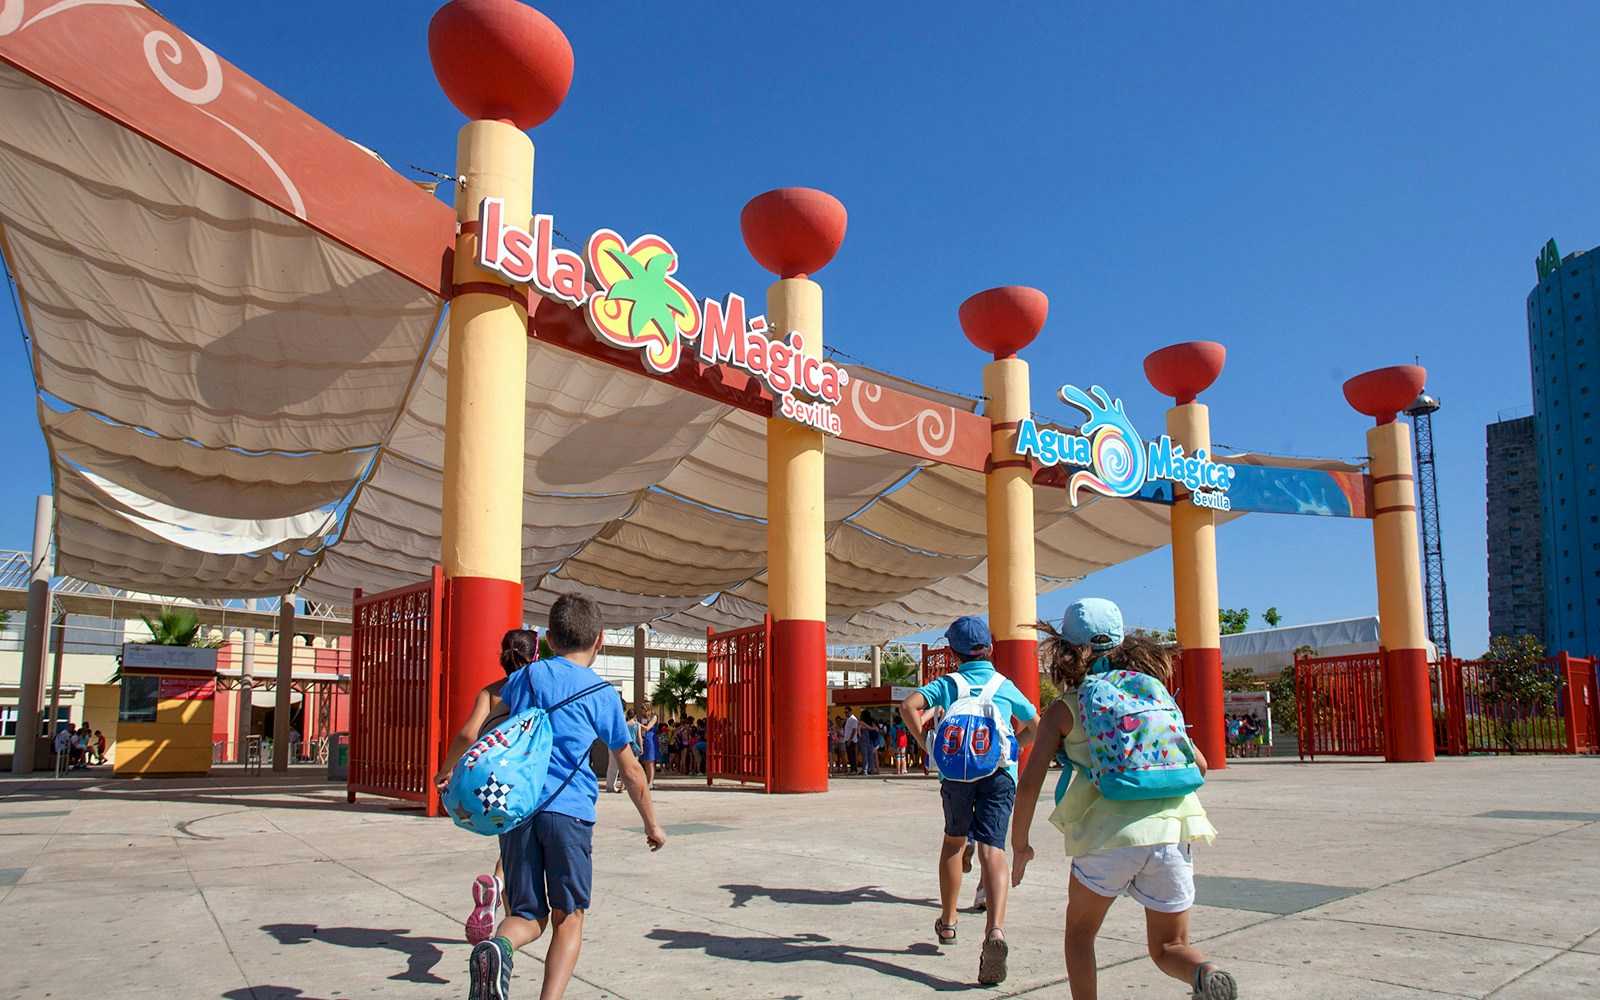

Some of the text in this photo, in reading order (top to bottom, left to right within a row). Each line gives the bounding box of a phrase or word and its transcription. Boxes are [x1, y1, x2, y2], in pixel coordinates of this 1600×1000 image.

[480, 197, 587, 305] Isla
[781, 393, 842, 436] Sevilla
[1016, 419, 1091, 466] Agua
[1193, 491, 1231, 511] Sevilla
